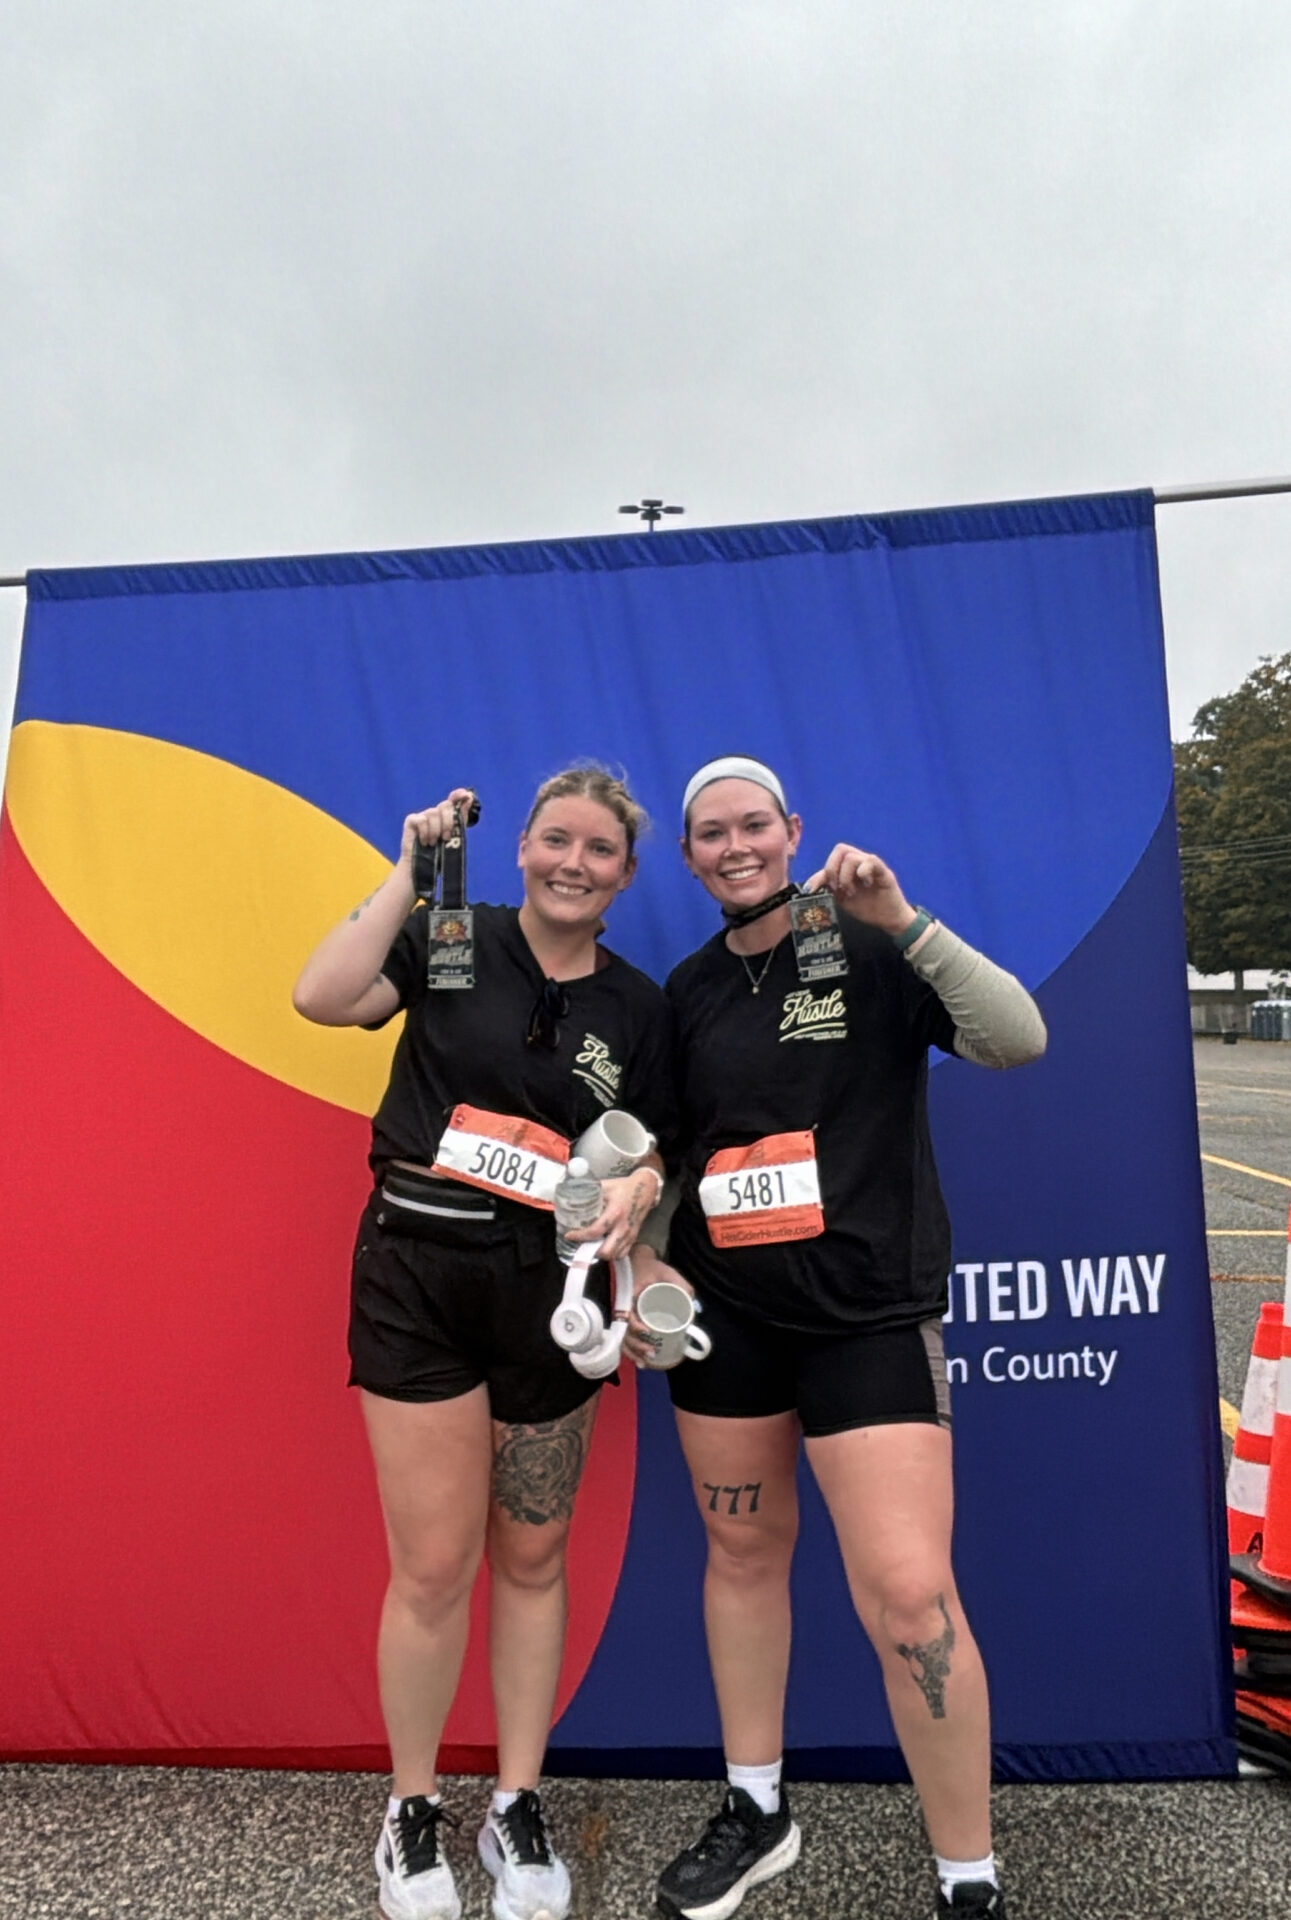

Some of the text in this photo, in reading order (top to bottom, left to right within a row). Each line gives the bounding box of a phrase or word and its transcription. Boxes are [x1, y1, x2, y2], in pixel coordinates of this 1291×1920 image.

[779, 989, 846, 1030] Hustle
[575, 1038, 622, 1090] Hustle
[468, 1143, 537, 1192] 5084
[728, 1170, 785, 1210] 5481
[1061, 1254, 1166, 1317] WAY
[982, 1346, 1118, 1386] County
[703, 1481, 762, 1515] 777
